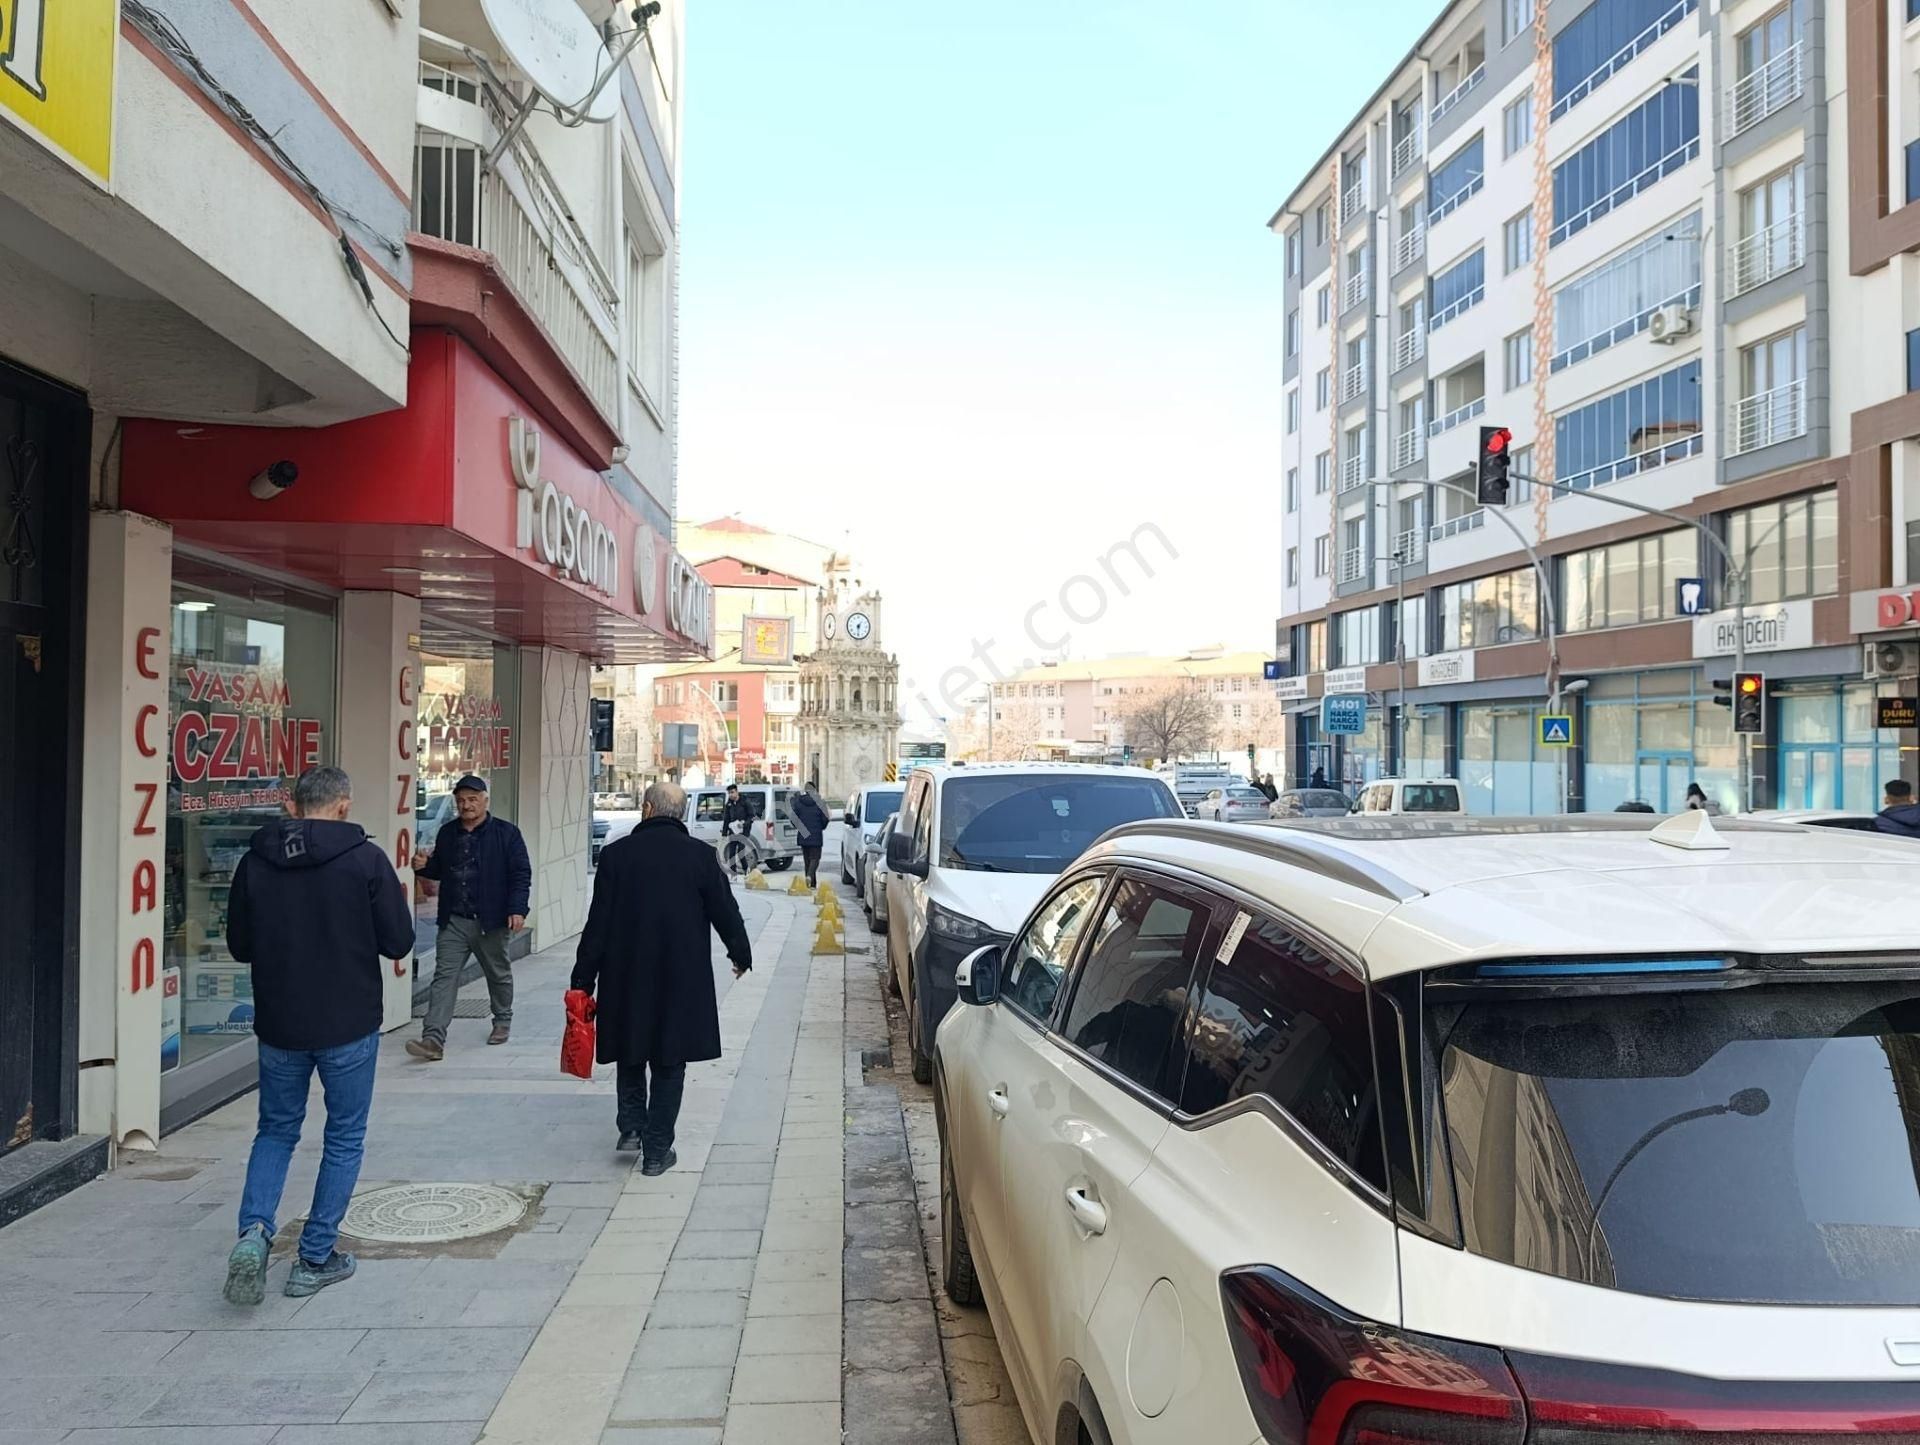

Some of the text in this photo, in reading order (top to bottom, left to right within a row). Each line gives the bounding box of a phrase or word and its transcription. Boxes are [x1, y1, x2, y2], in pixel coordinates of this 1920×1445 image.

[185, 667, 291, 708] YAŞAM
[1883, 709, 1915, 718] DURU
[167, 711, 321, 783] CZANE
[429, 726, 512, 773] ECZANE
[181, 793, 206, 812] Ecz.
[208, 789, 251, 811] Hüseyin
